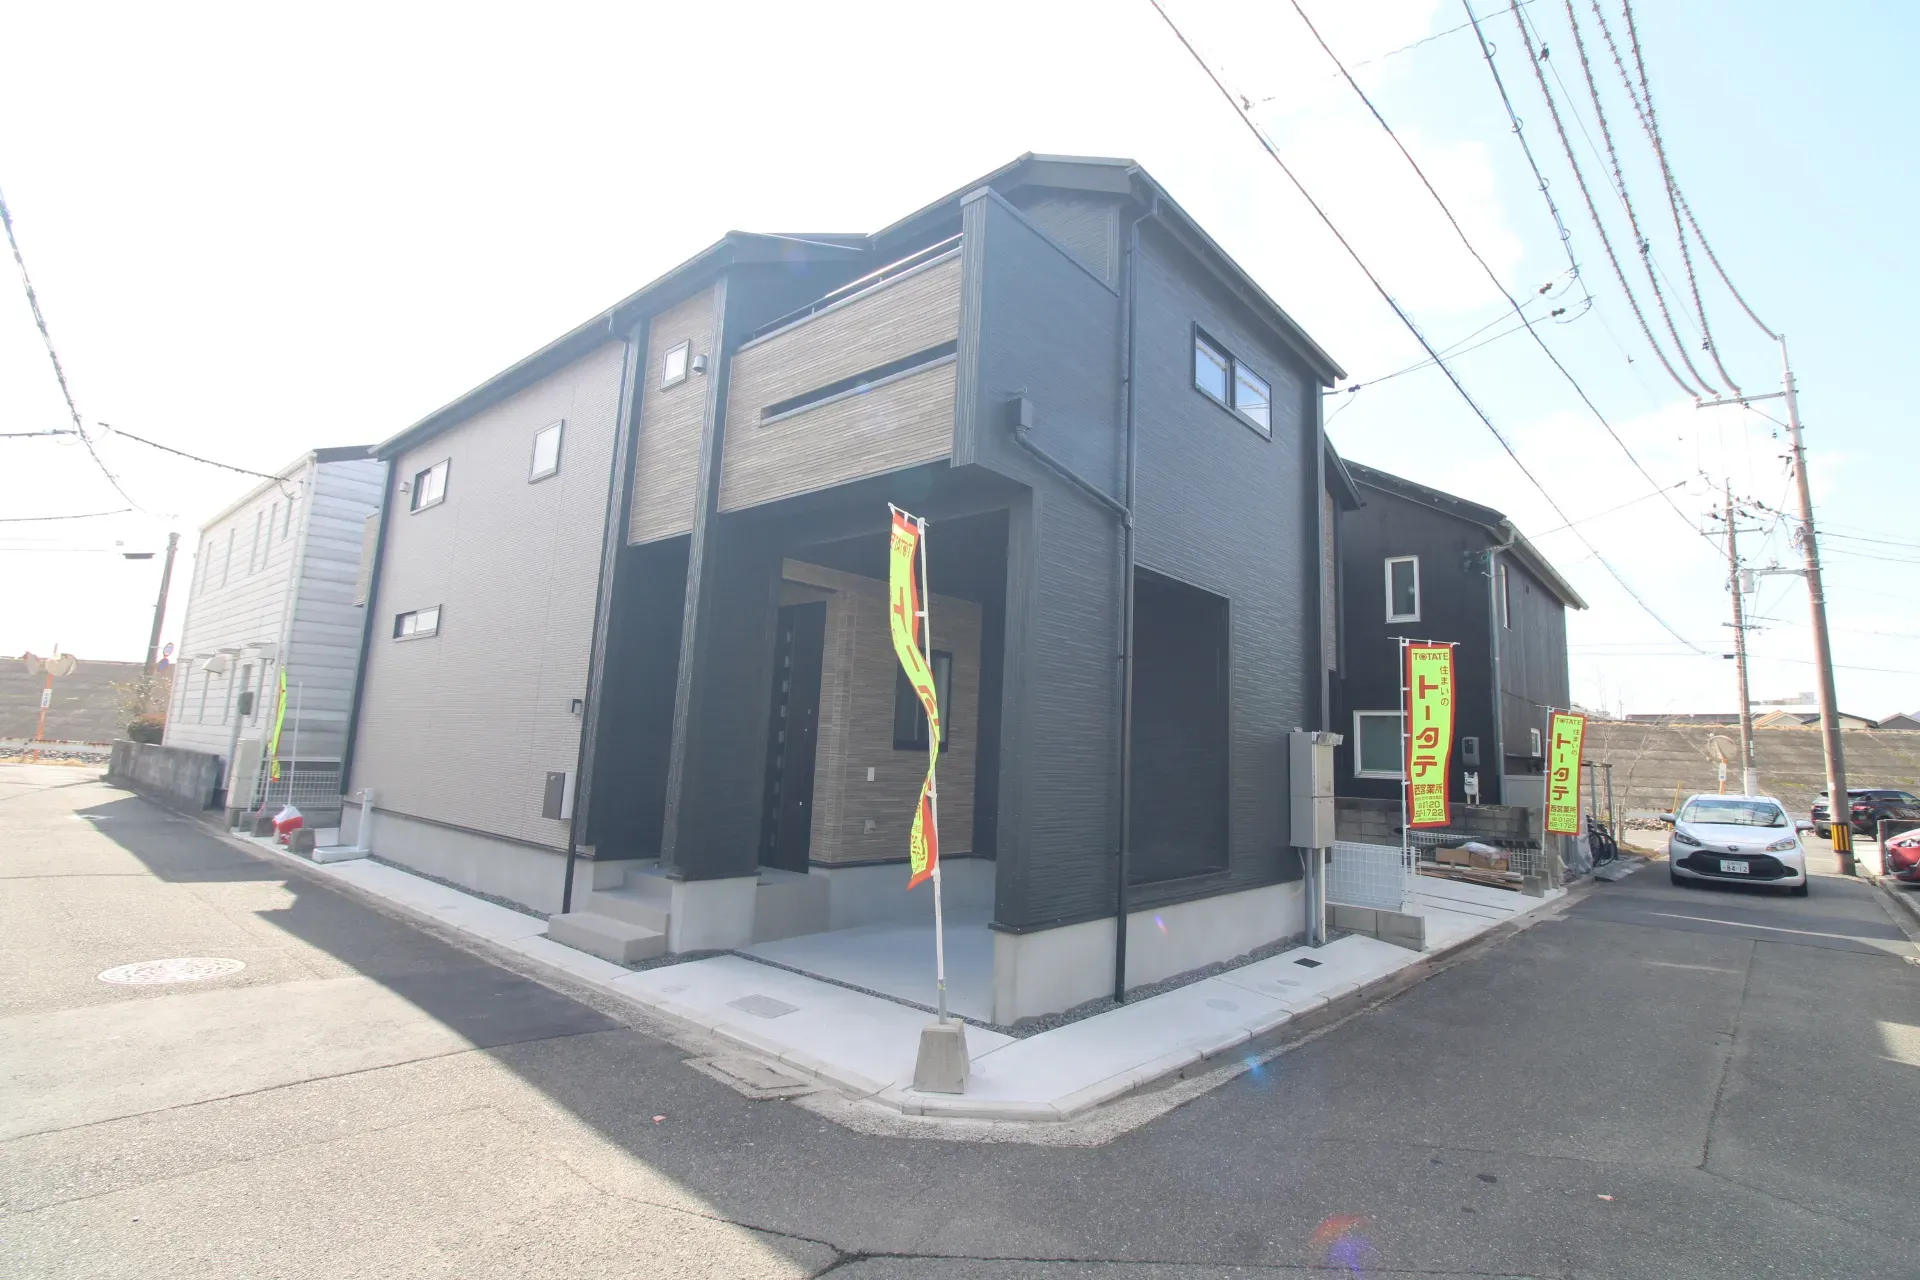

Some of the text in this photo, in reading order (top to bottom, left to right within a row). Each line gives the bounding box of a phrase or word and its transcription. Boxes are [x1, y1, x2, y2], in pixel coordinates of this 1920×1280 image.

[1440, 665, 1449, 706] 住まいの
[1413, 675, 1439, 777] トータテ
[1556, 717, 1582, 726] TOTATE
[1552, 733, 1571, 800] トータテ
